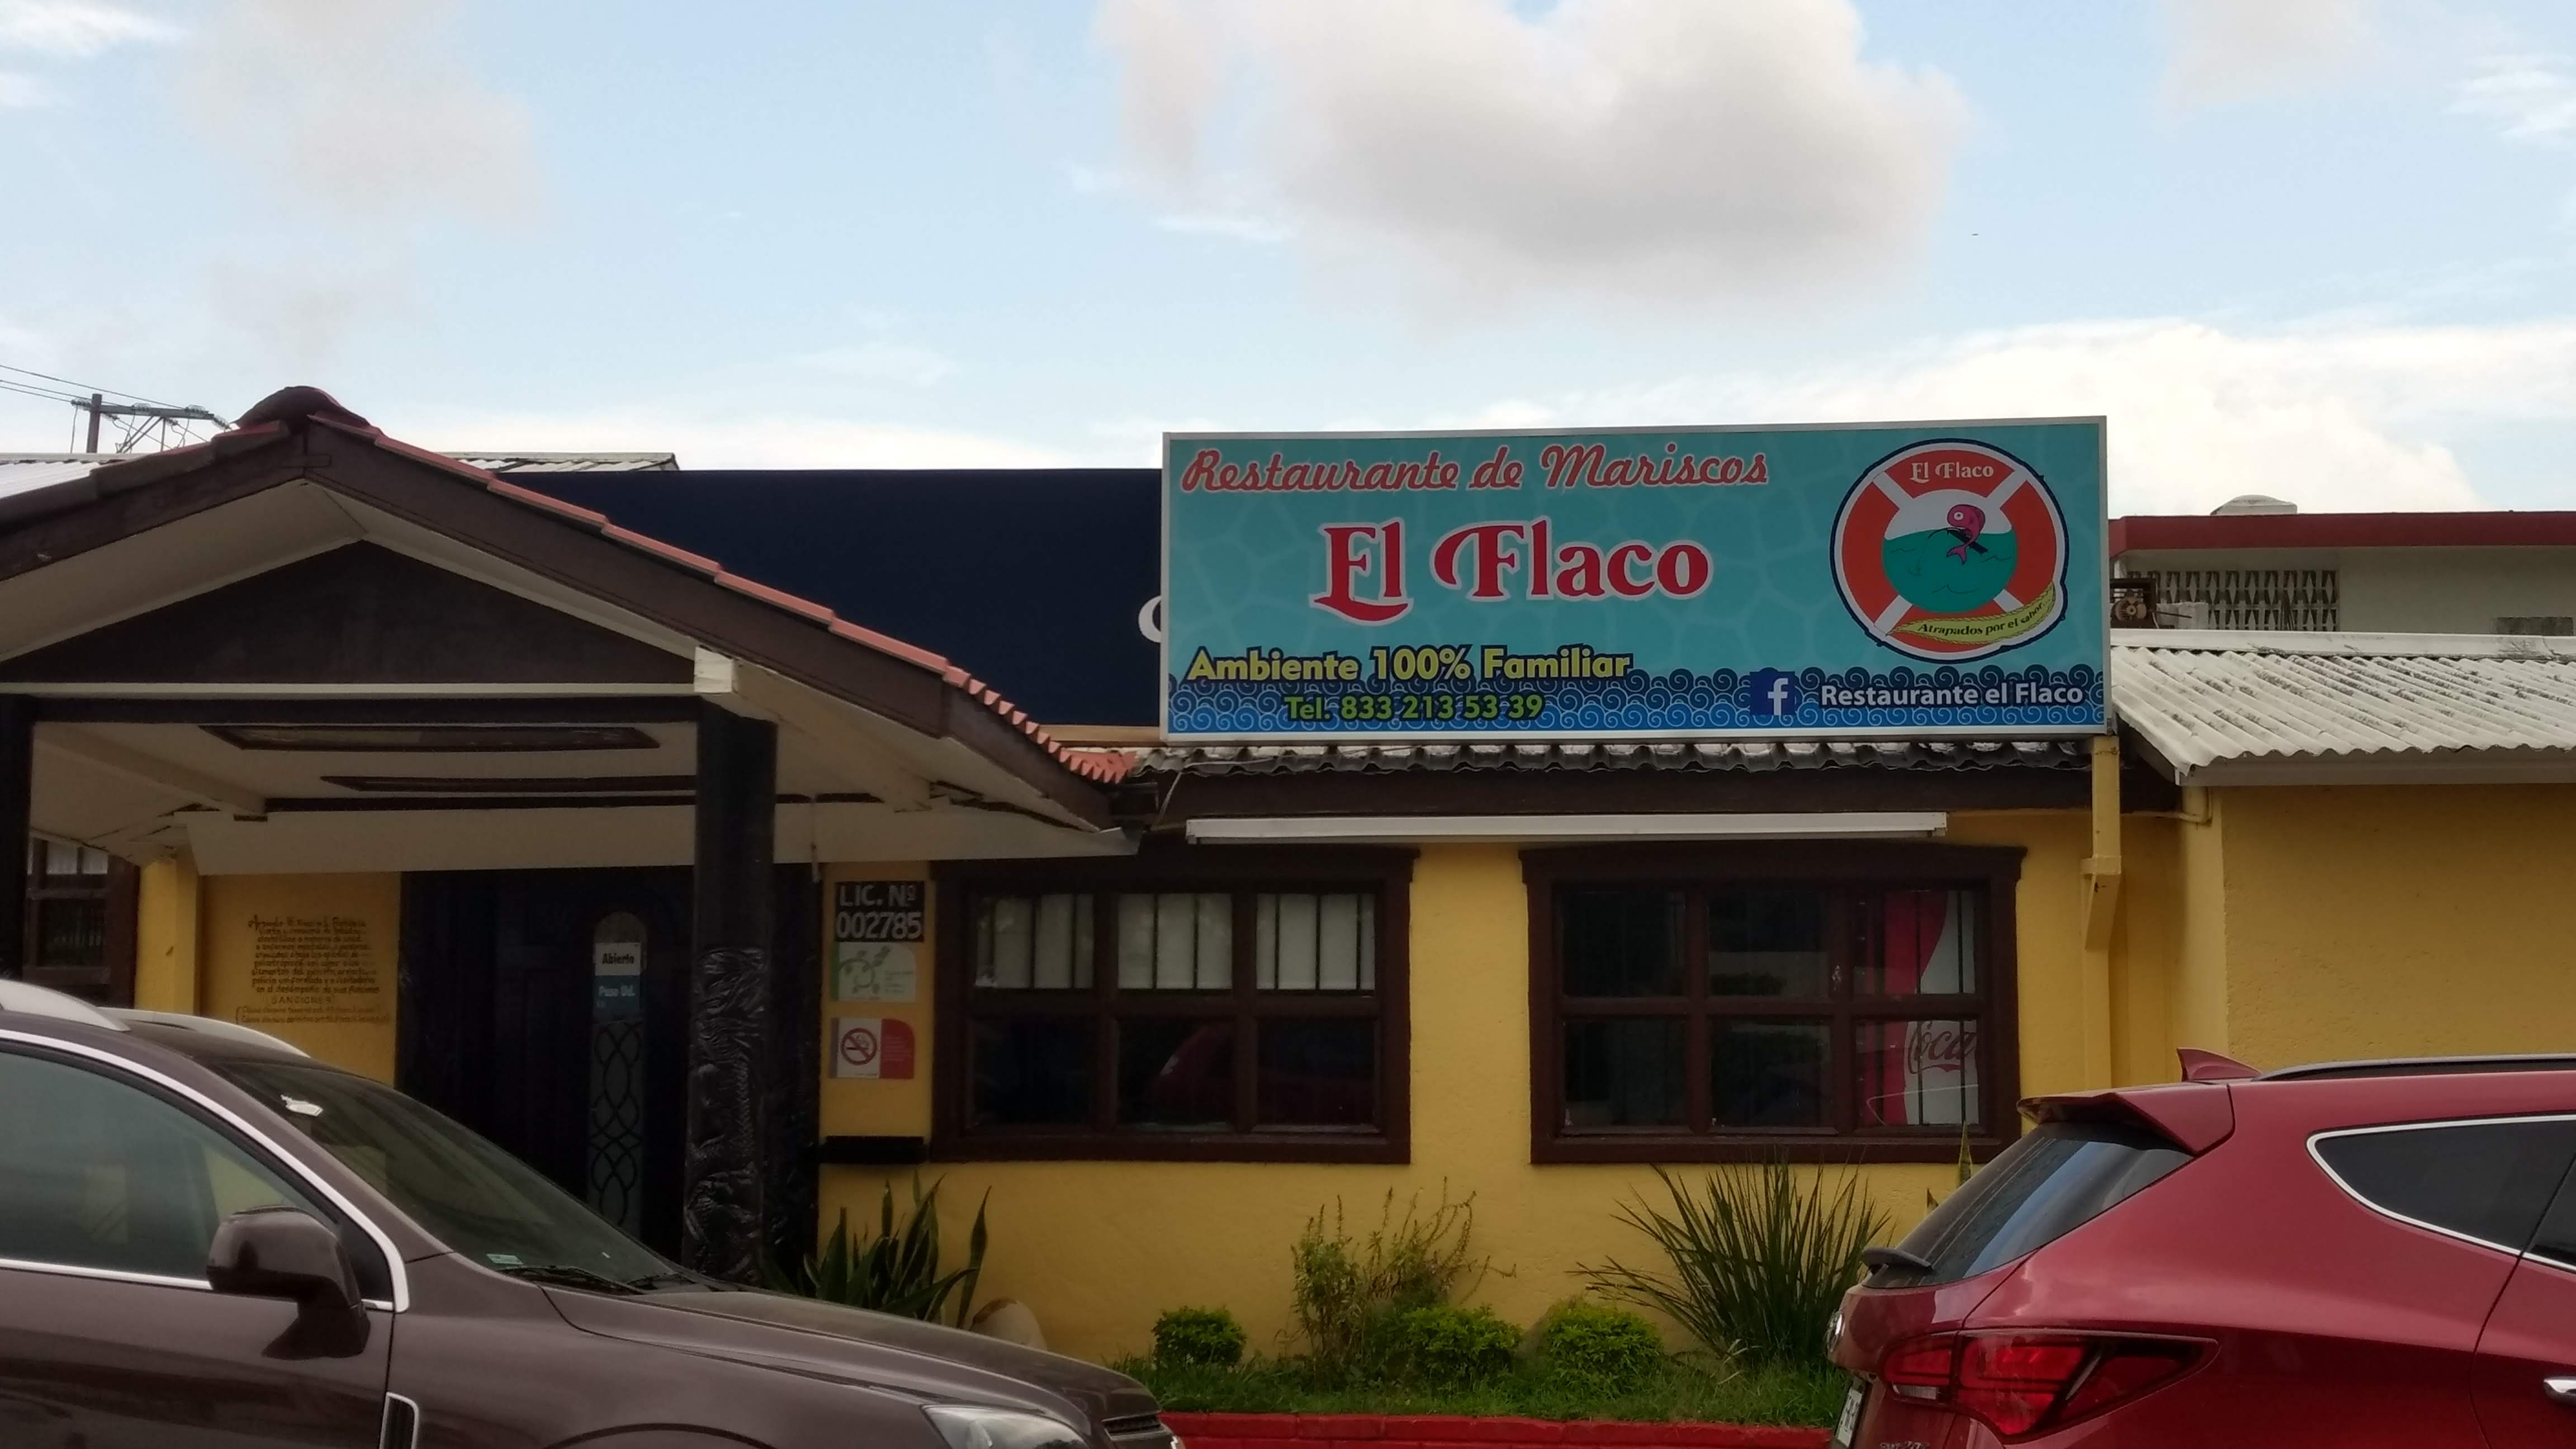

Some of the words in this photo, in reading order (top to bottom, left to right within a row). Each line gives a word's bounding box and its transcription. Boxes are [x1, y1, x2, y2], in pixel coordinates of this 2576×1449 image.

[1181, 448, 1458, 493] Restaurante
[1468, 446, 1524, 490] de
[1540, 442, 1769, 489] Mariscos
[1910, 461, 1930, 484] El
[1934, 461, 1994, 479] Flaco
[1313, 520, 1410, 622] El
[1433, 518, 1711, 599] Flaco
[1918, 623, 1983, 636] Atrapados
[1985, 623, 2005, 636] por
[2007, 620, 2019, 629] el
[1187, 648, 1360, 681] Ambiente
[1374, 648, 1472, 680] 100%
[1485, 647, 1631, 679] Familiar
[1285, 697, 1330, 721] Tel.
[1341, 695, 1393, 719] 833
[1402, 695, 1455, 719] 213
[1462, 695, 1498, 718] 53
[1507, 694, 1544, 718] 39
[1767, 678, 1789, 716] f
[1821, 684, 1978, 706] Restaurante
[1980, 683, 2007, 704] el
[2015, 682, 2083, 705] Flaco
[840, 885, 882, 907] LIC.
[836, 911, 922, 940] 002785
[602, 953, 634, 964] Abierto
